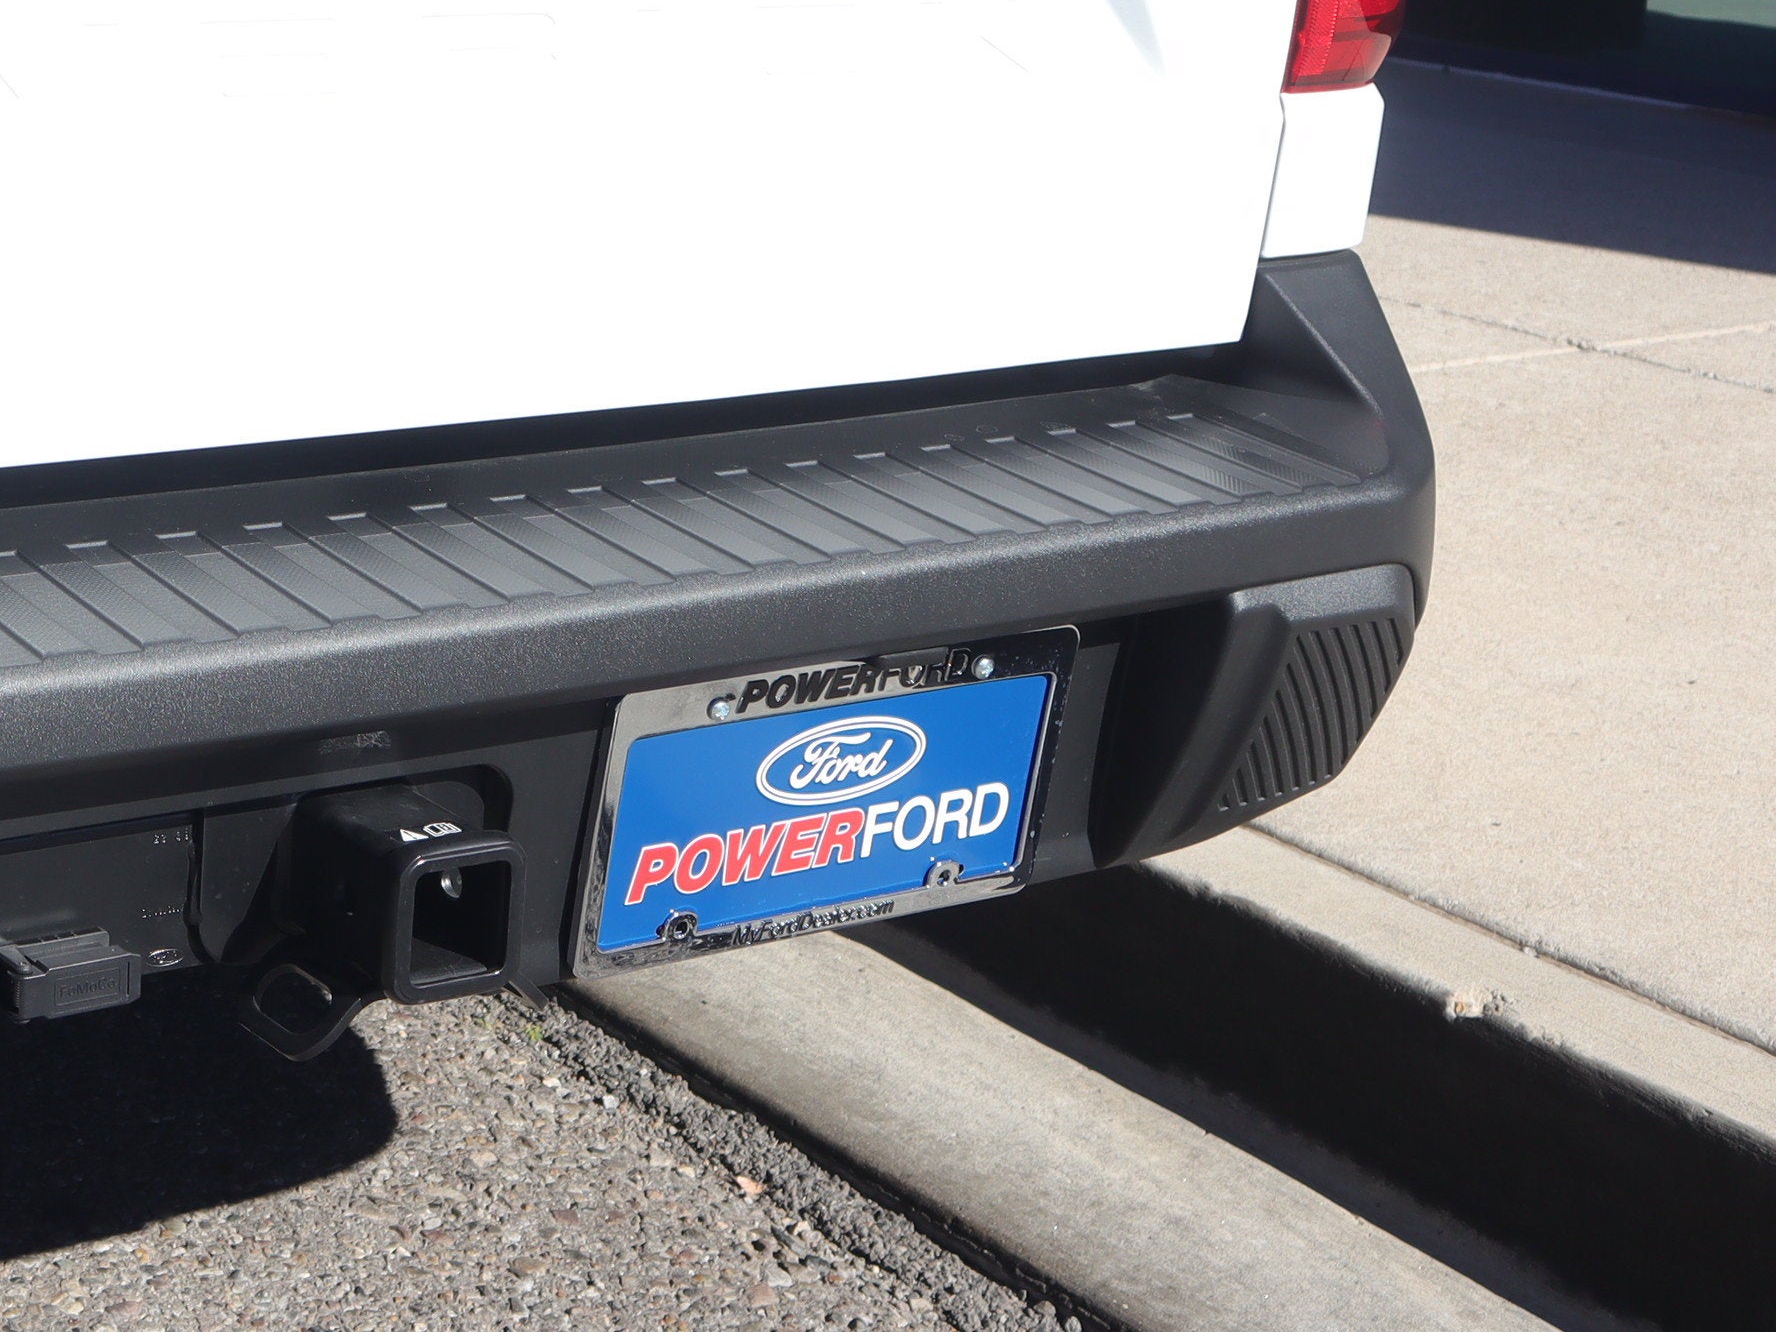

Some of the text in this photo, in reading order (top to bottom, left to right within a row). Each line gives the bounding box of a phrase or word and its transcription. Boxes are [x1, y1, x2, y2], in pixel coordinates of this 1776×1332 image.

[735, 648, 972, 714] POWERFORD
[790, 731, 896, 790] Ford
[624, 782, 1009, 906] POWERFORD
